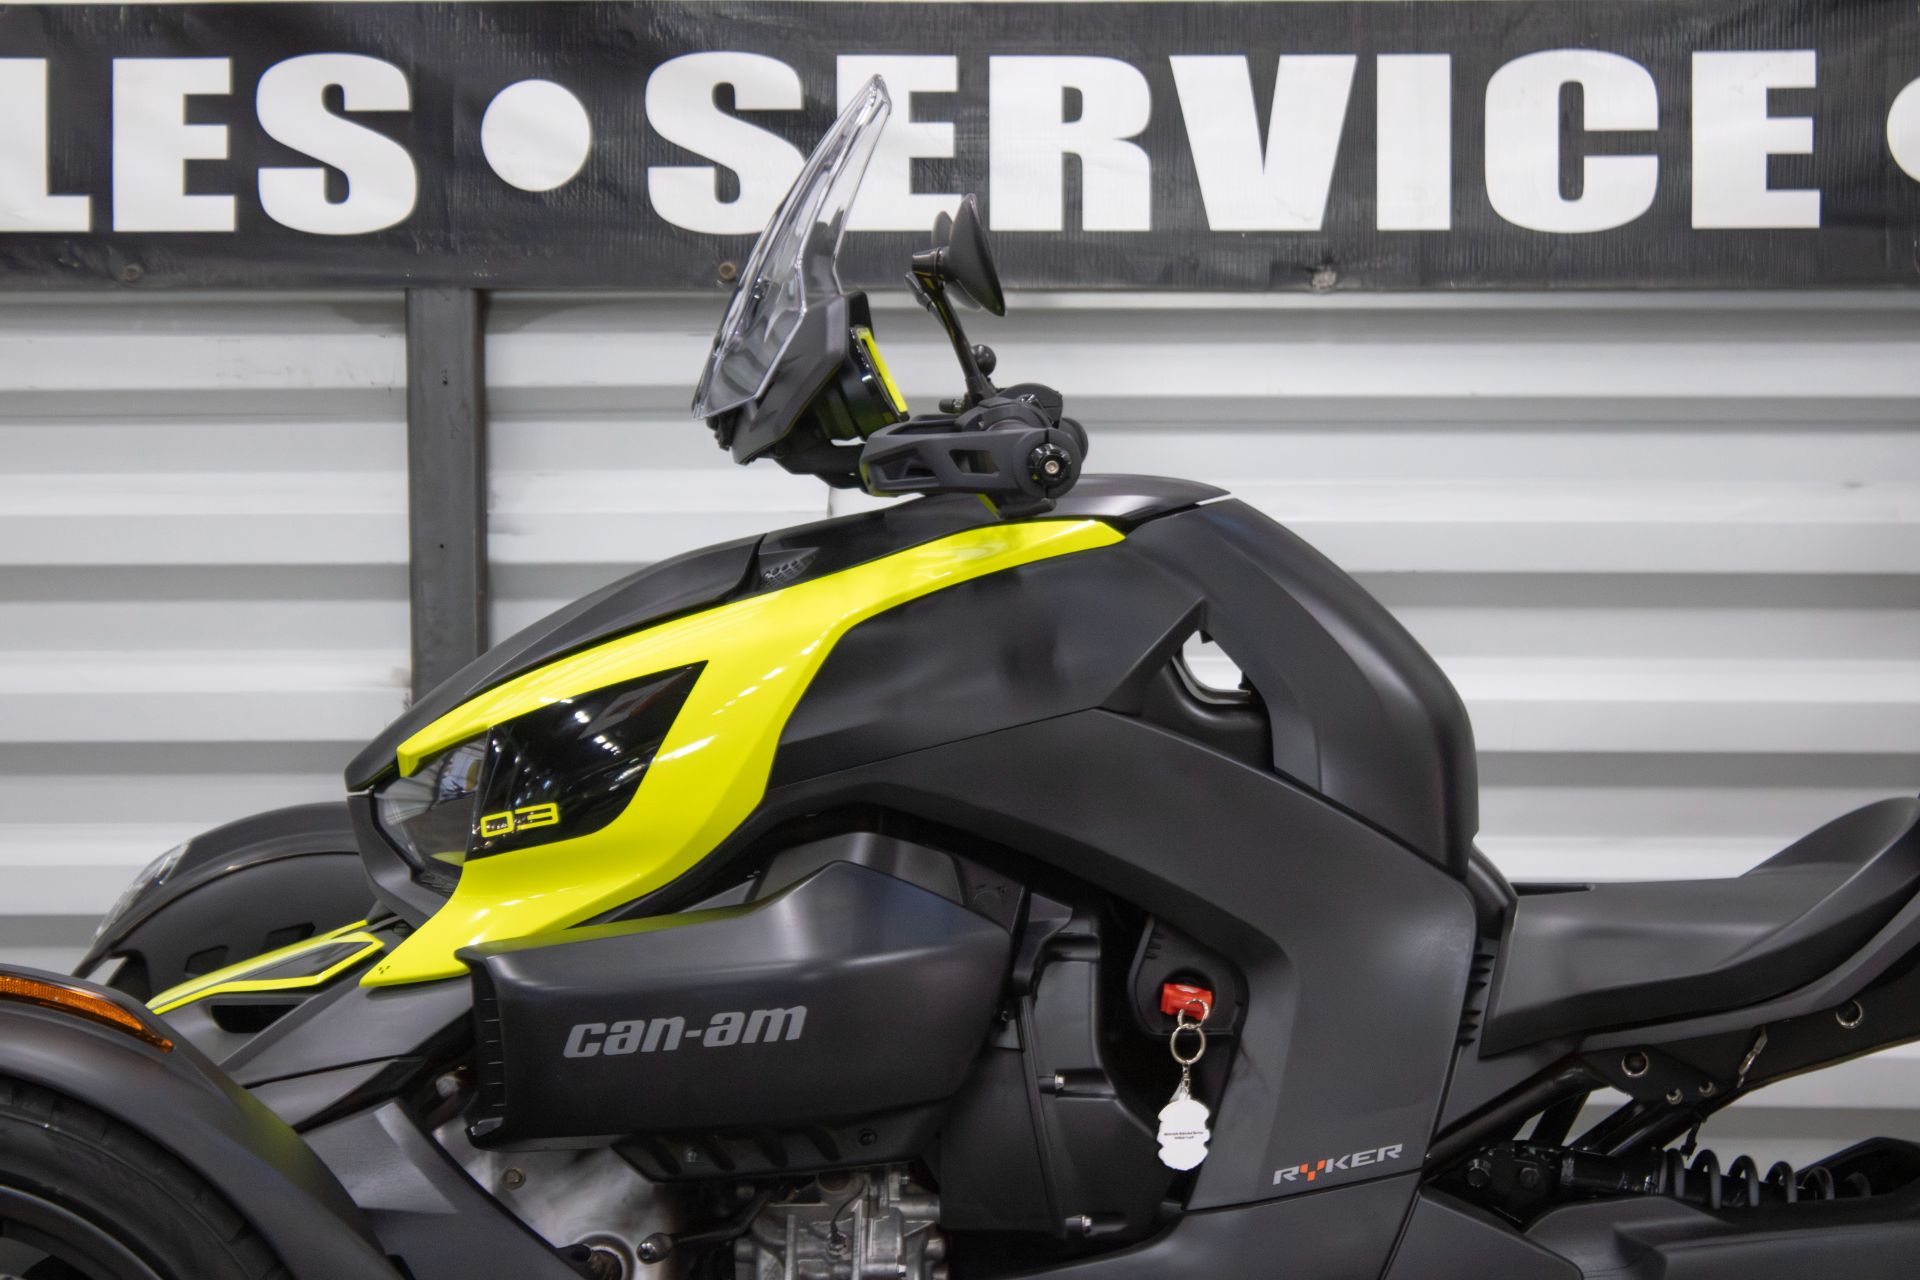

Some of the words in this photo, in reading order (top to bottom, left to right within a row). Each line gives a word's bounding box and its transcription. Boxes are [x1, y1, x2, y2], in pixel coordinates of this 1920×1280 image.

[645, 48, 1821, 236] SERVICE
[563, 1004, 808, 1059] can-am
[1272, 1143, 1403, 1186] RYKER
